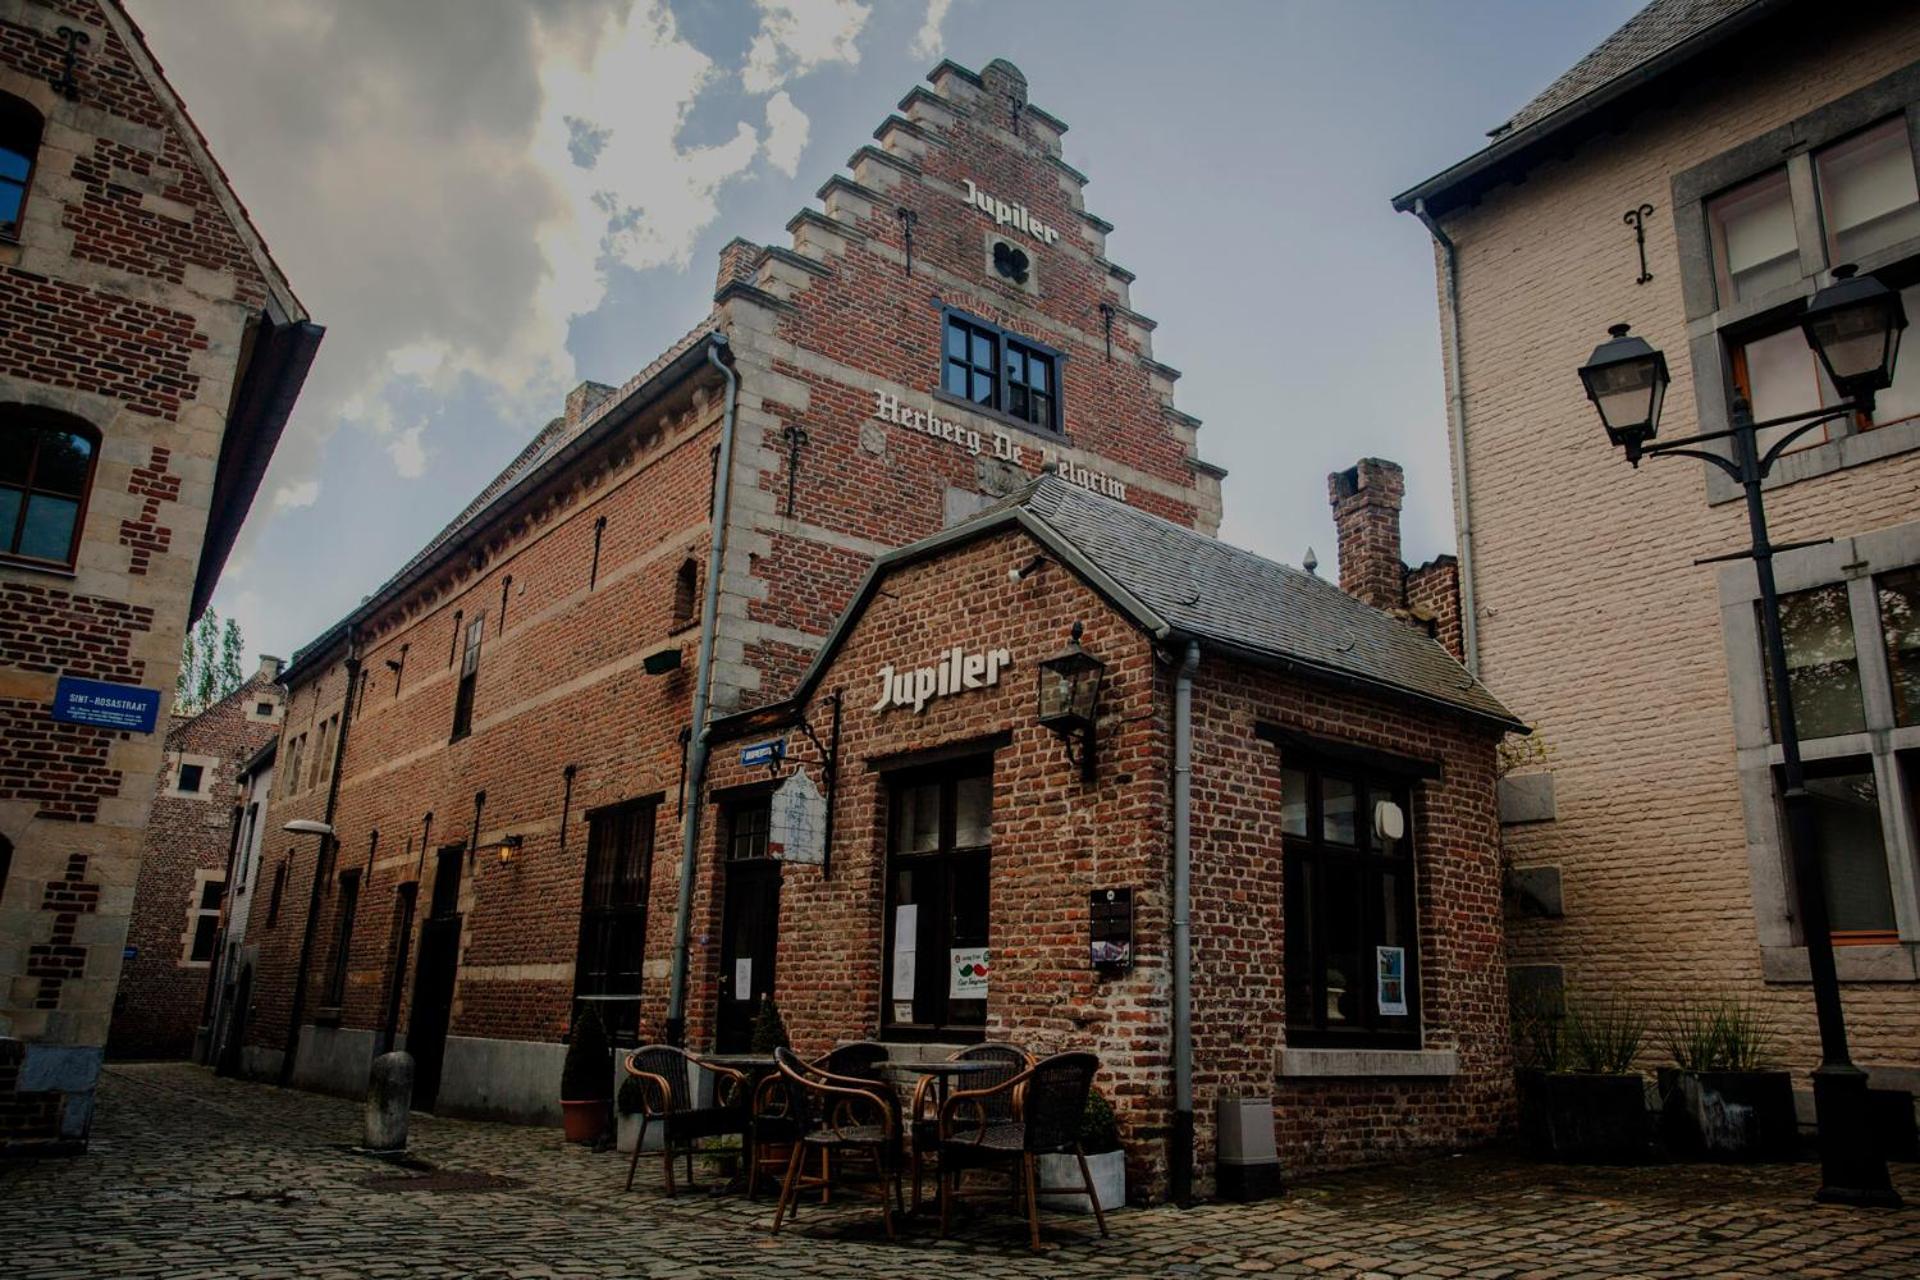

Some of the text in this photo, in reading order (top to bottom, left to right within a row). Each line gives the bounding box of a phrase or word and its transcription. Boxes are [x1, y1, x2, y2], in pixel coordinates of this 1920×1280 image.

[963, 178, 1060, 245] Jupiler
[873, 388, 1127, 501] Herberg De elgrim
[871, 646, 1011, 714] Jupiler
